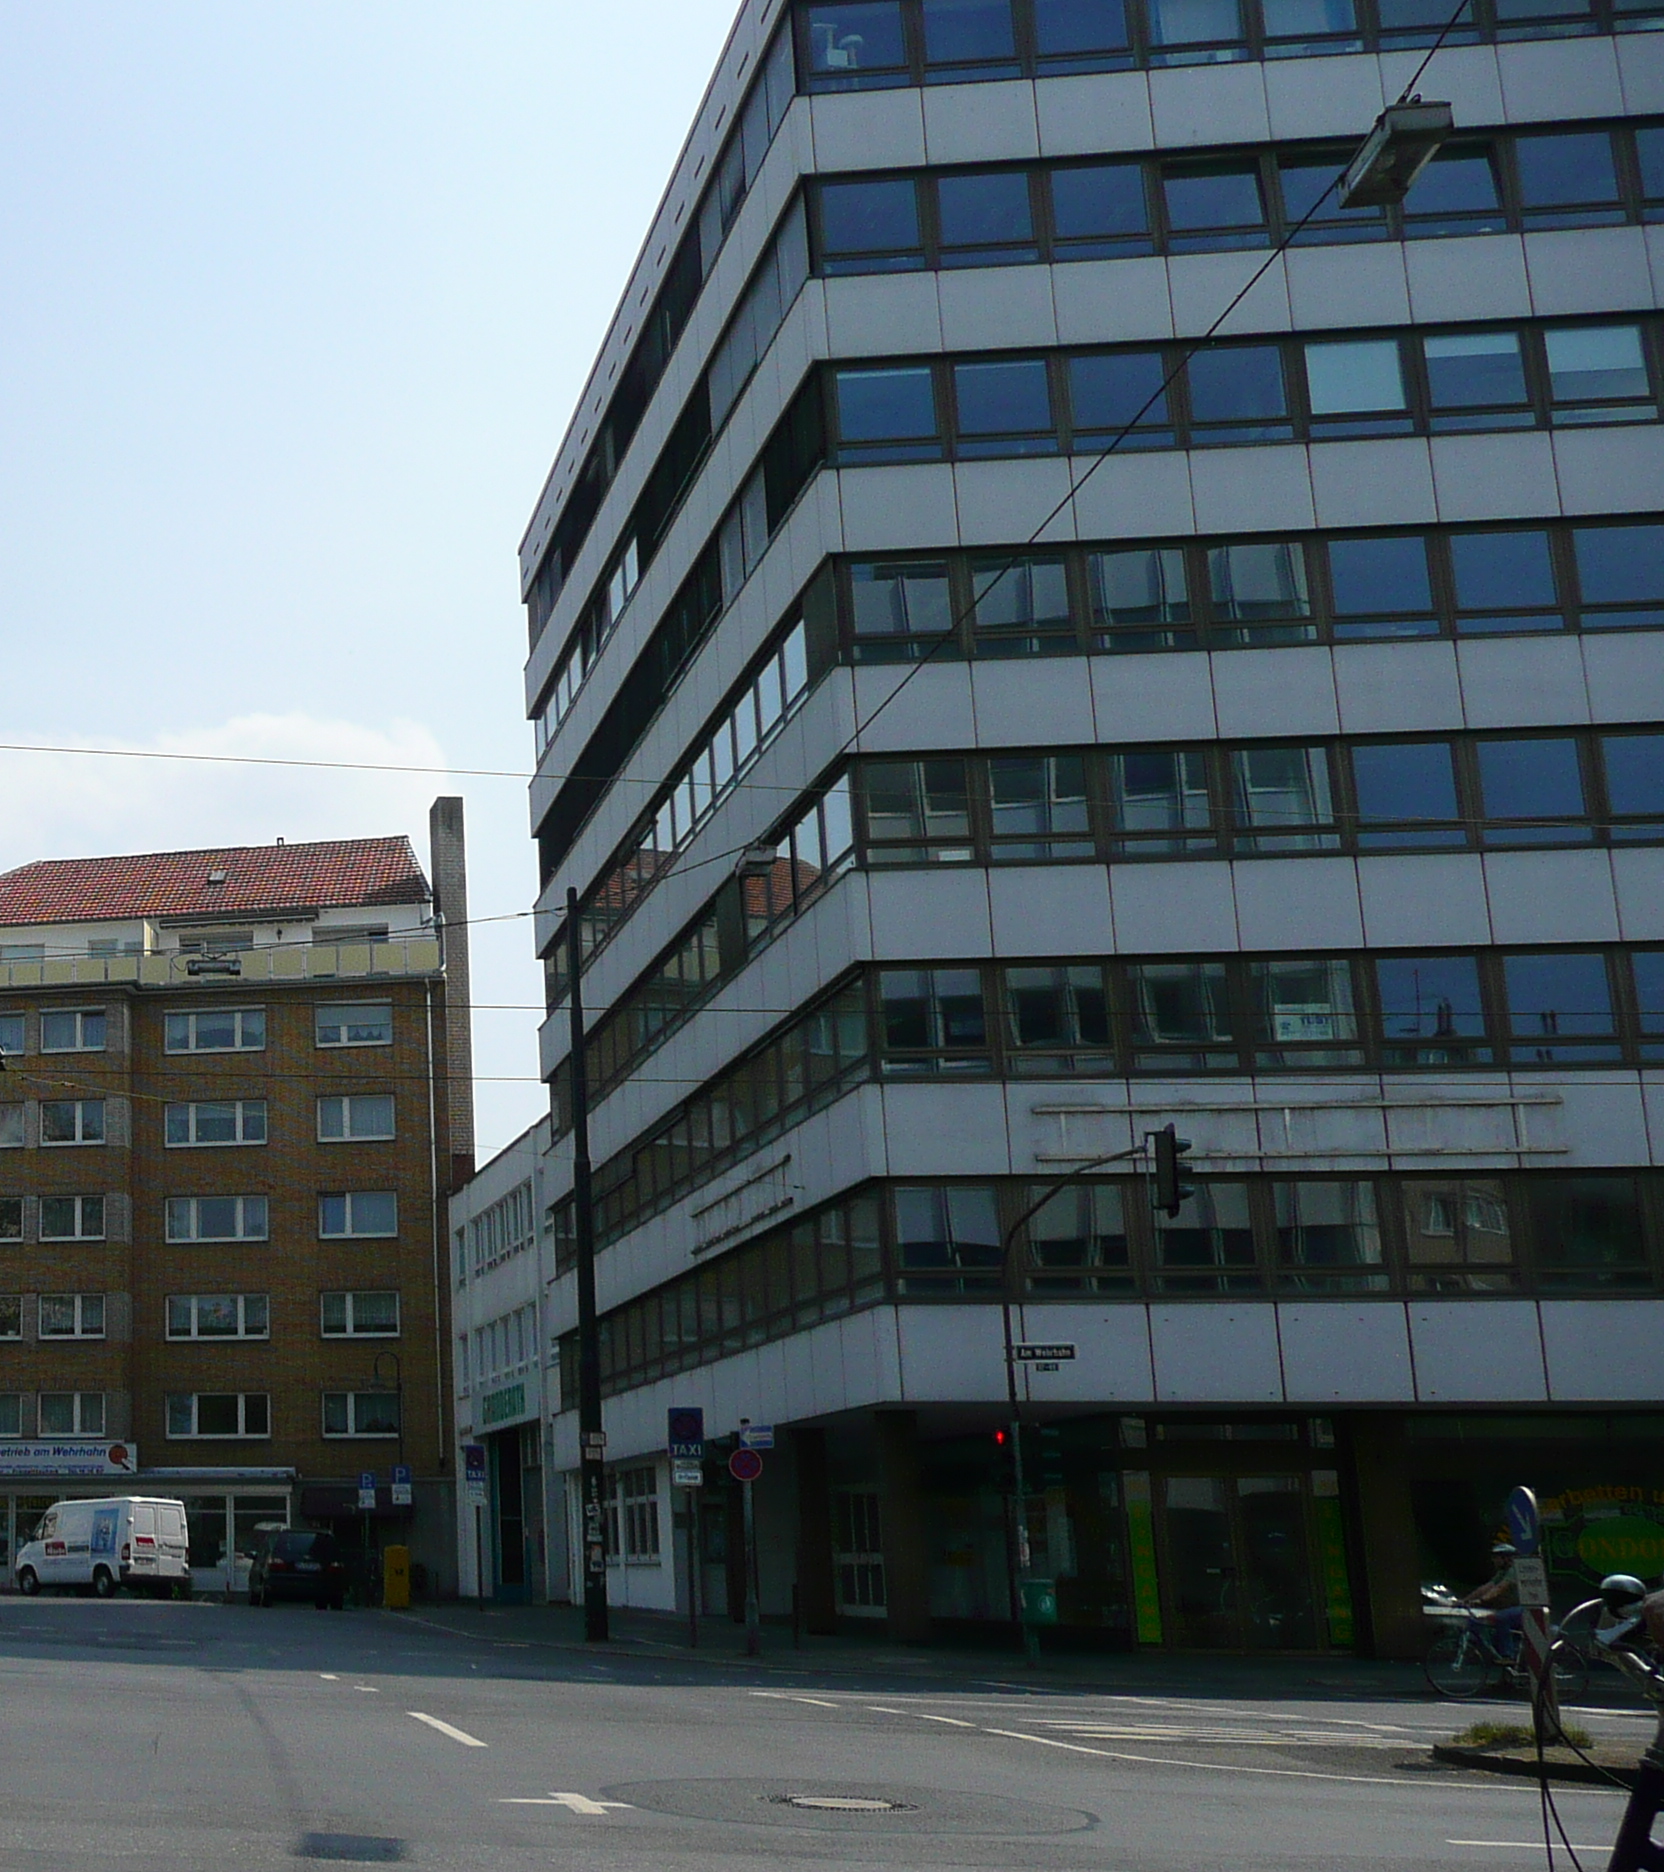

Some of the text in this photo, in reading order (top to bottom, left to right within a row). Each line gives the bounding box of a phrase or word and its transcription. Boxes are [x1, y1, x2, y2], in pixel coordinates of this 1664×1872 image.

[1020, 1348, 1071, 1357] Am Wehrhahn
[33, 1448, 50, 1457] am
[52, 1446, 106, 1457] Wehrhahn
[673, 1443, 702, 1456] TAXI
[395, 1467, 406, 1483] P
